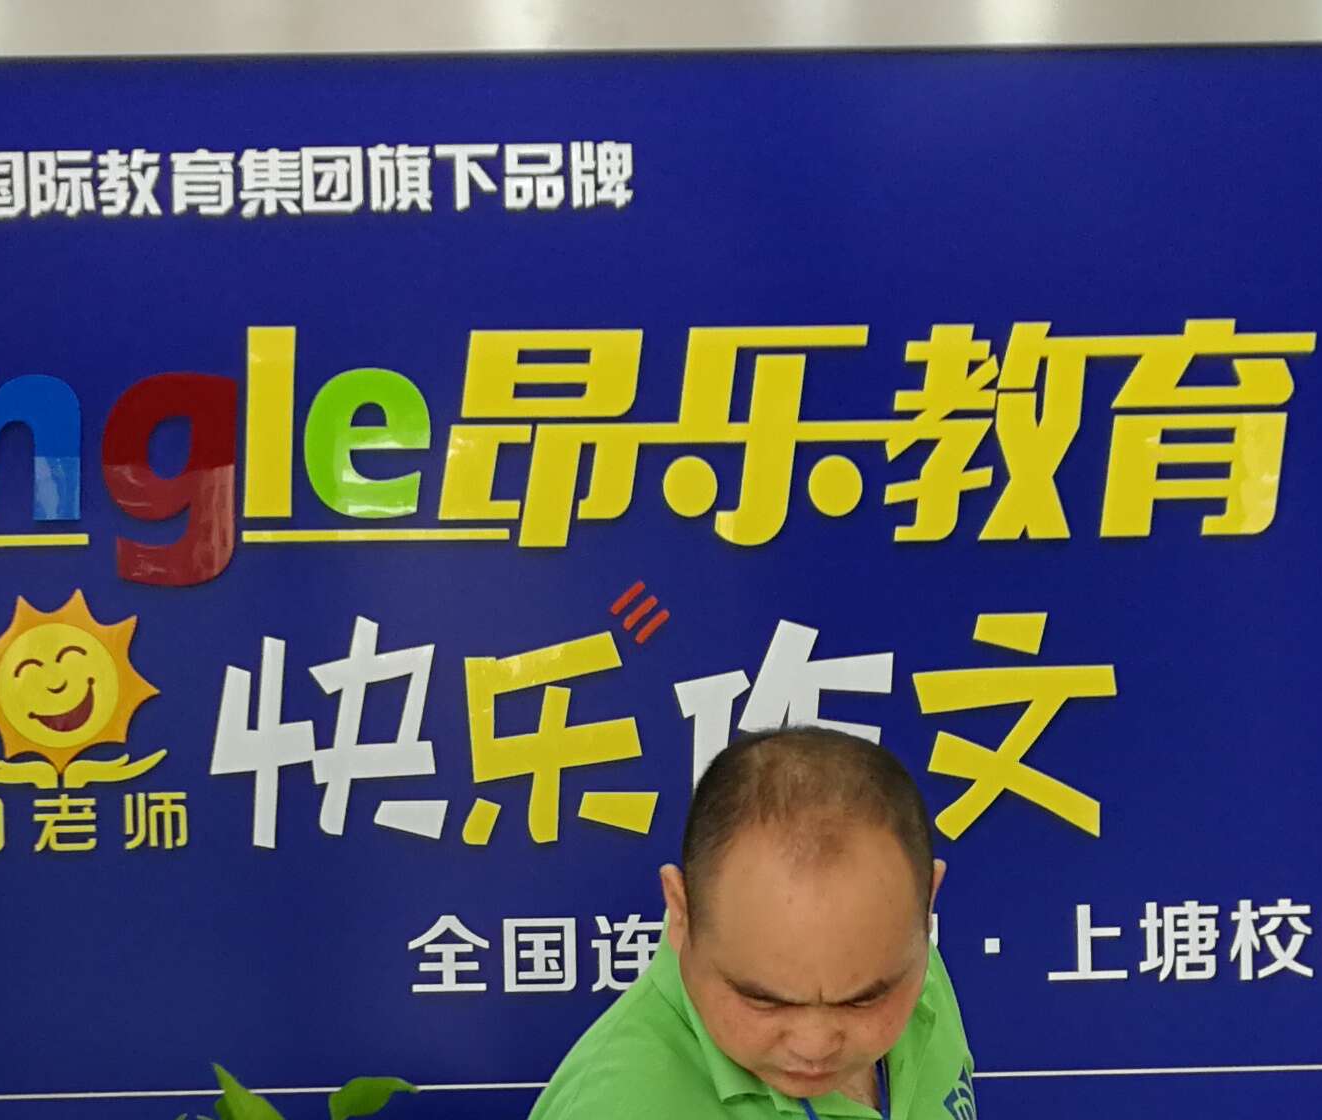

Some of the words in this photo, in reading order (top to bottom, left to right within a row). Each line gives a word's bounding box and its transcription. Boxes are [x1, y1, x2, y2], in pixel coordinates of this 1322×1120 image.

[437, 317, 1317, 549] 昂乐教育
[209, 611, 1117, 849] 快乐作文
